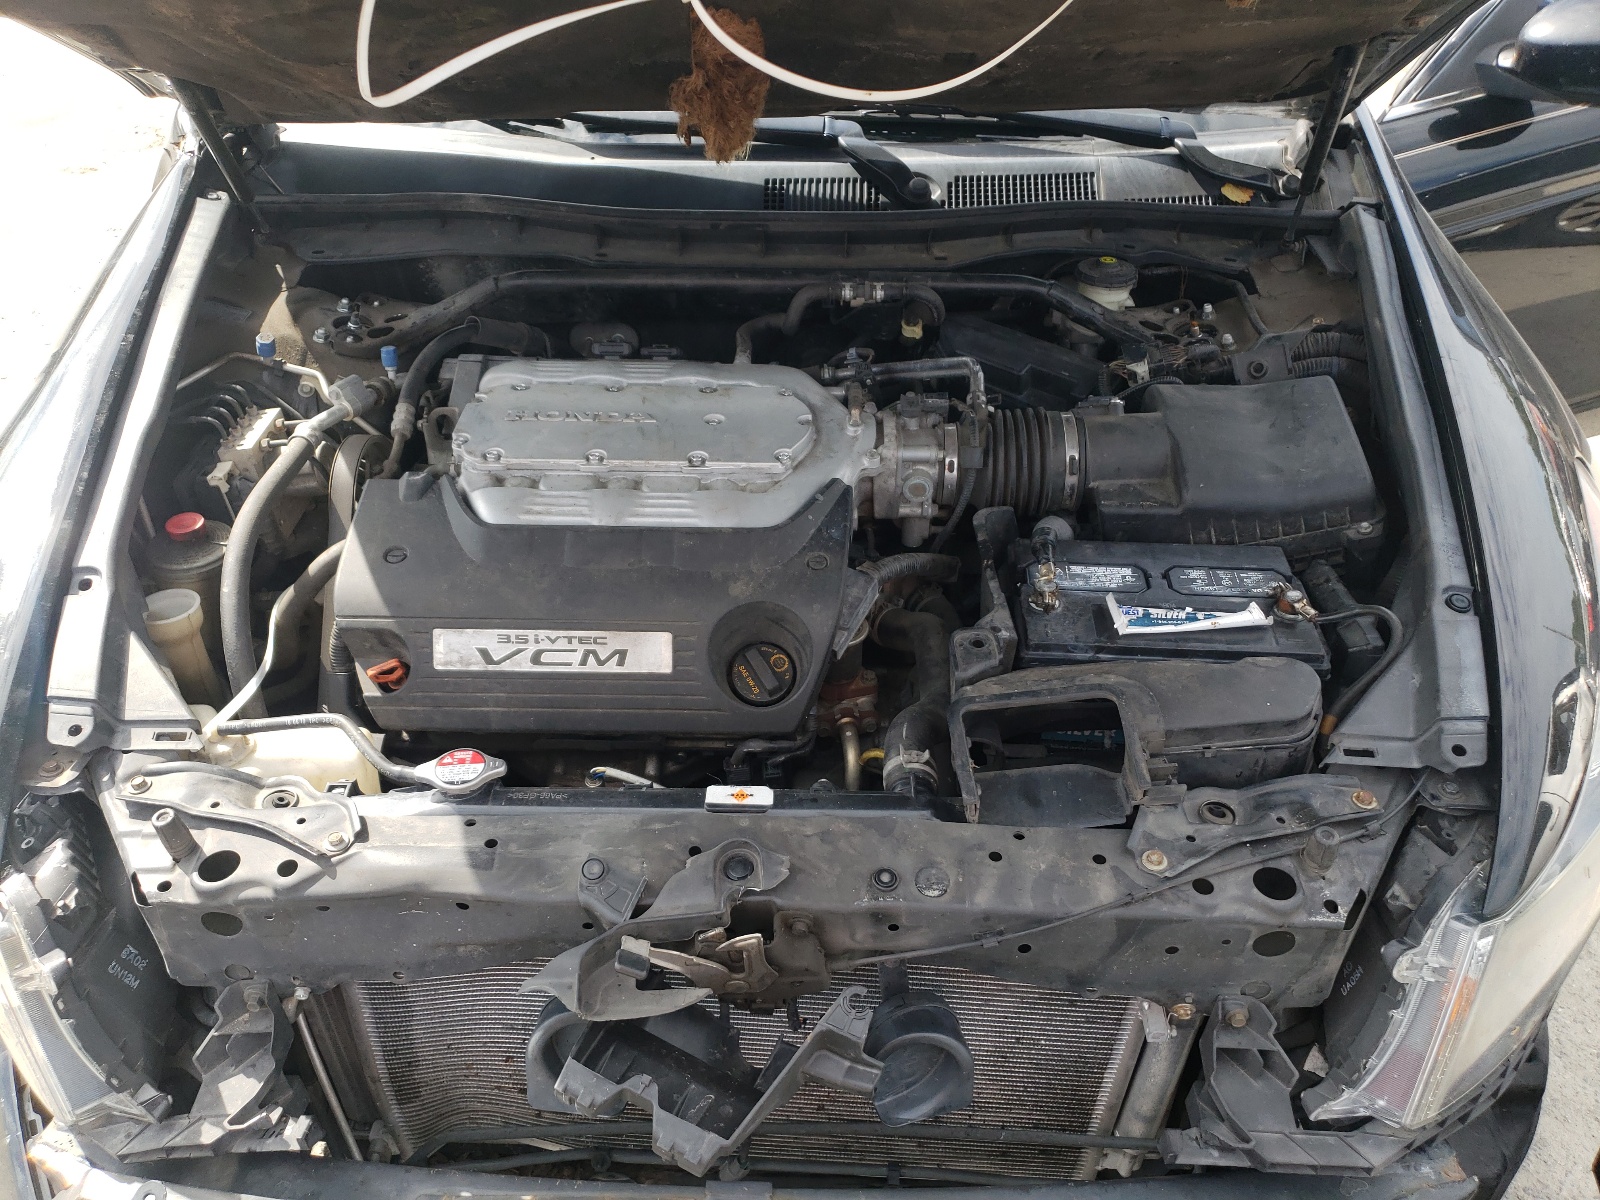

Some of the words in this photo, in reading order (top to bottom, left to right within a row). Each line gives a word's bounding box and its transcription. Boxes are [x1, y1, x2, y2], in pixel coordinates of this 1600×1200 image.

[504, 410, 657, 423] HONDA
[1149, 610, 1187, 620] SILVER
[496, 633, 529, 645] 3.5
[533, 633, 609, 646] i-VTEC
[474, 646, 629, 668] VCM
[738, 665, 750, 678] SAE
[746, 677, 760, 694] 0W-20
